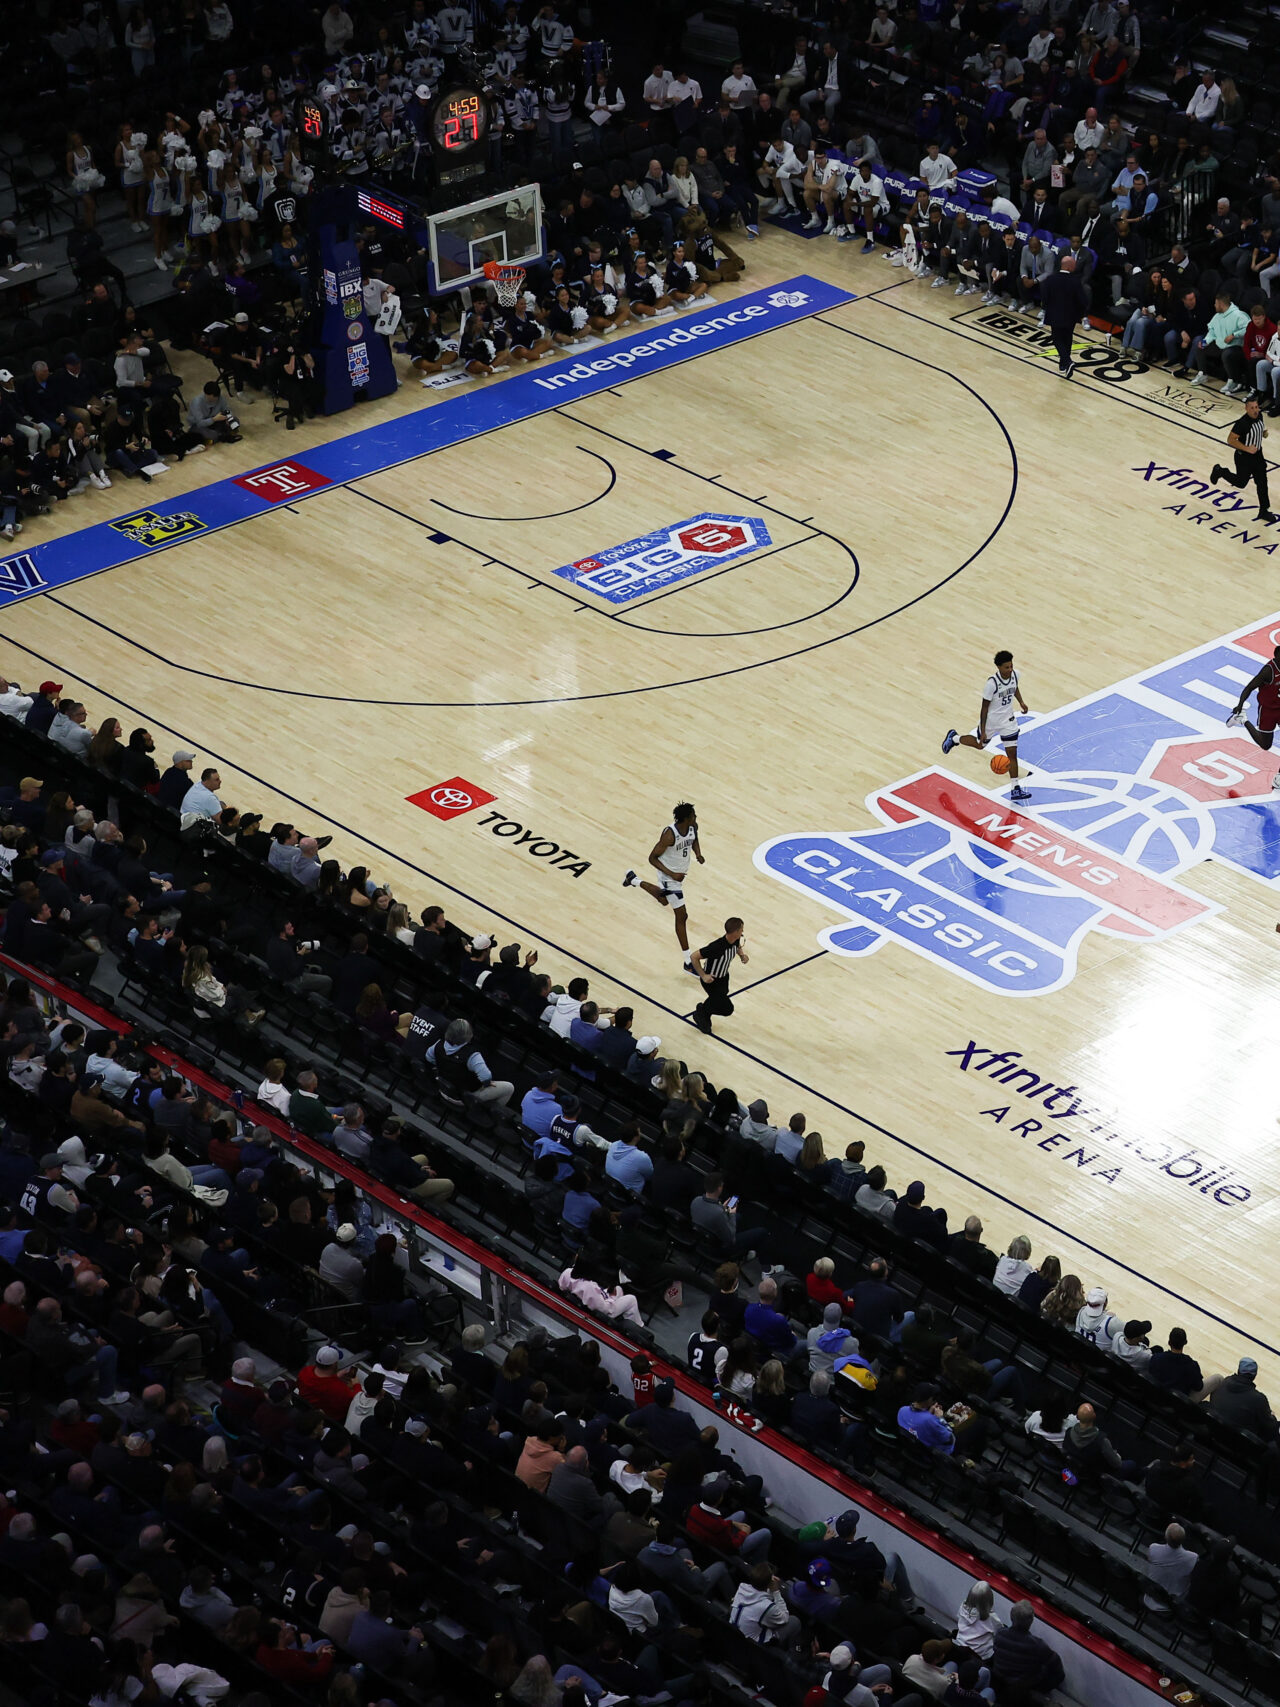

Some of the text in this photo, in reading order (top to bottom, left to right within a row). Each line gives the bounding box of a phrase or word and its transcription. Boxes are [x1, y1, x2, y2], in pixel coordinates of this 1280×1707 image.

[449, 96, 479, 116] 4:59
[304, 118, 320, 136] 27
[444, 114, 479, 149] 27
[901, 189, 917, 198] PU
[944, 202, 966, 214] PURE
[966, 212, 988, 222] PURE
[340, 279, 363, 298] IBX
[978, 313, 1054, 348] IBEW
[532, 303, 771, 391] Independence
[1155, 385, 1216, 413] NECA
[1131, 461, 1260, 513] xfinity
[692, 529, 732, 547] 5
[1161, 503, 1280, 555] ARENA
[599, 541, 652, 562] TOYOTA
[589, 549, 685, 588] BIG
[615, 557, 707, 596] CLASSIC
[1002, 695, 1012, 706] 55
[1182, 750, 1262, 787] 5
[477, 811, 593, 878] TOYOTA
[974, 813, 1120, 887] MEN'S
[793, 849, 1039, 977] CLASSIC
[410, 1022, 430, 1038] STAFF
[412, 1015, 435, 1031] EVENT
[945, 1040, 1098, 1119] xfinity
[979, 1105, 1124, 1184] ARENA
[692, 1348, 704, 1370] 2
